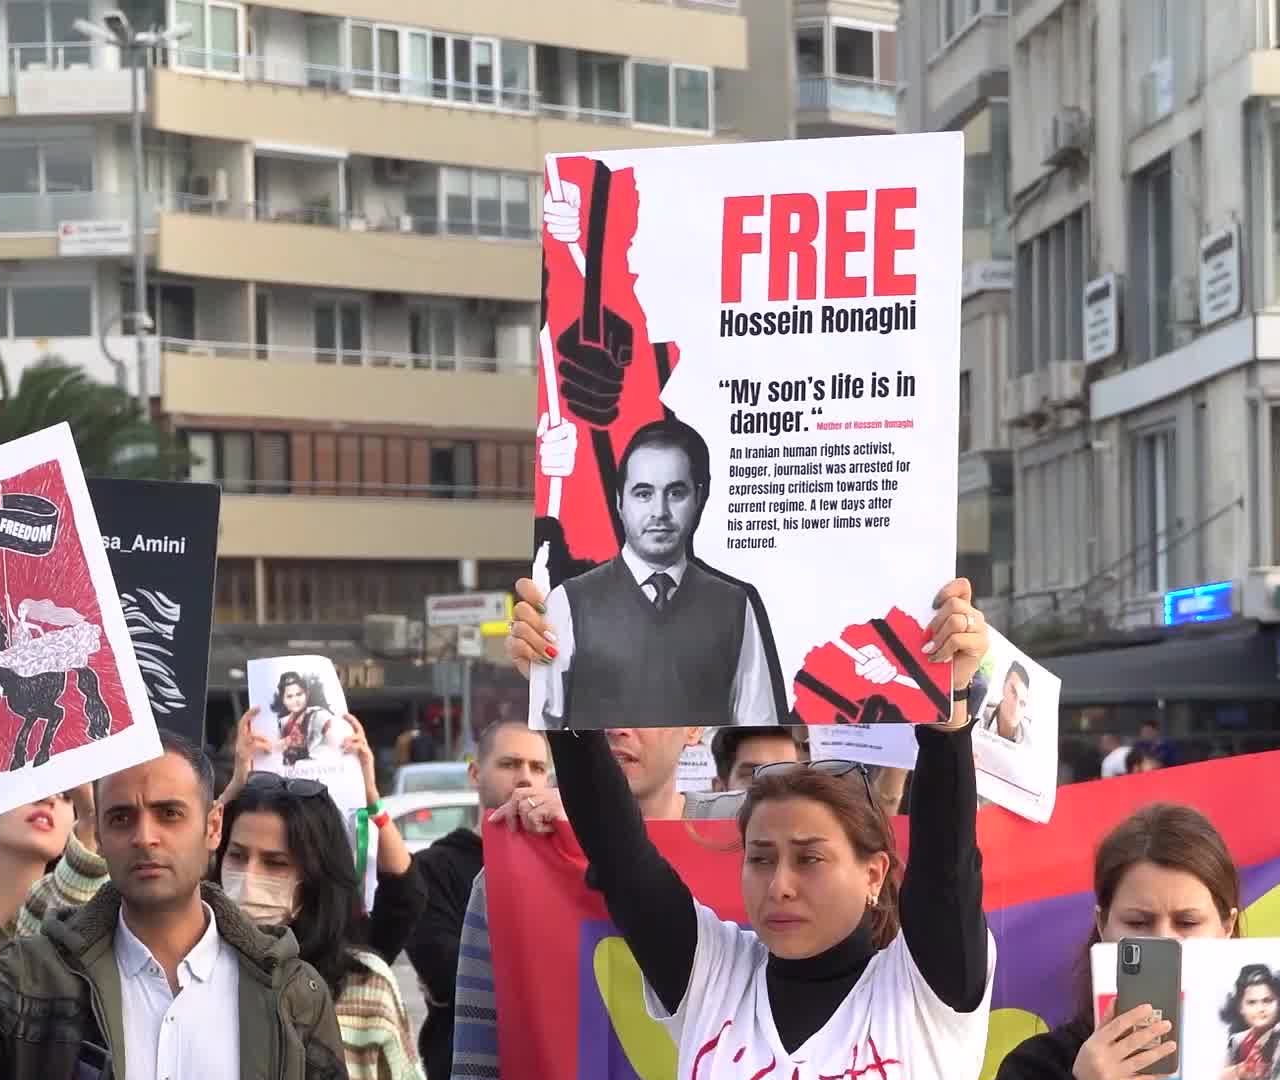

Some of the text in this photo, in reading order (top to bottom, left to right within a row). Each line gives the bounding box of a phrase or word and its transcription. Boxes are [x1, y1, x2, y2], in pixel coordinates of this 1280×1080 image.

[721, 187, 917, 303] FREE
[720, 300, 917, 337] Hossein Ronaghi
[719, 371, 916, 406] “My son’s life is in
[817, 421, 842, 431] Mother
[845, 421, 852, 430] of
[730, 442, 895, 459] An Iranian human rights activist,
[729, 460, 911, 478] Blogger, journalist was arrested for
[729, 479, 898, 496] expressing criticism towards the
[728, 497, 892, 513] current regime. A few days after
[0, 518, 52, 544] FREEDOM
[728, 515, 890, 531] his arrest, his lower limbs were
[727, 536, 777, 549] fractured.
